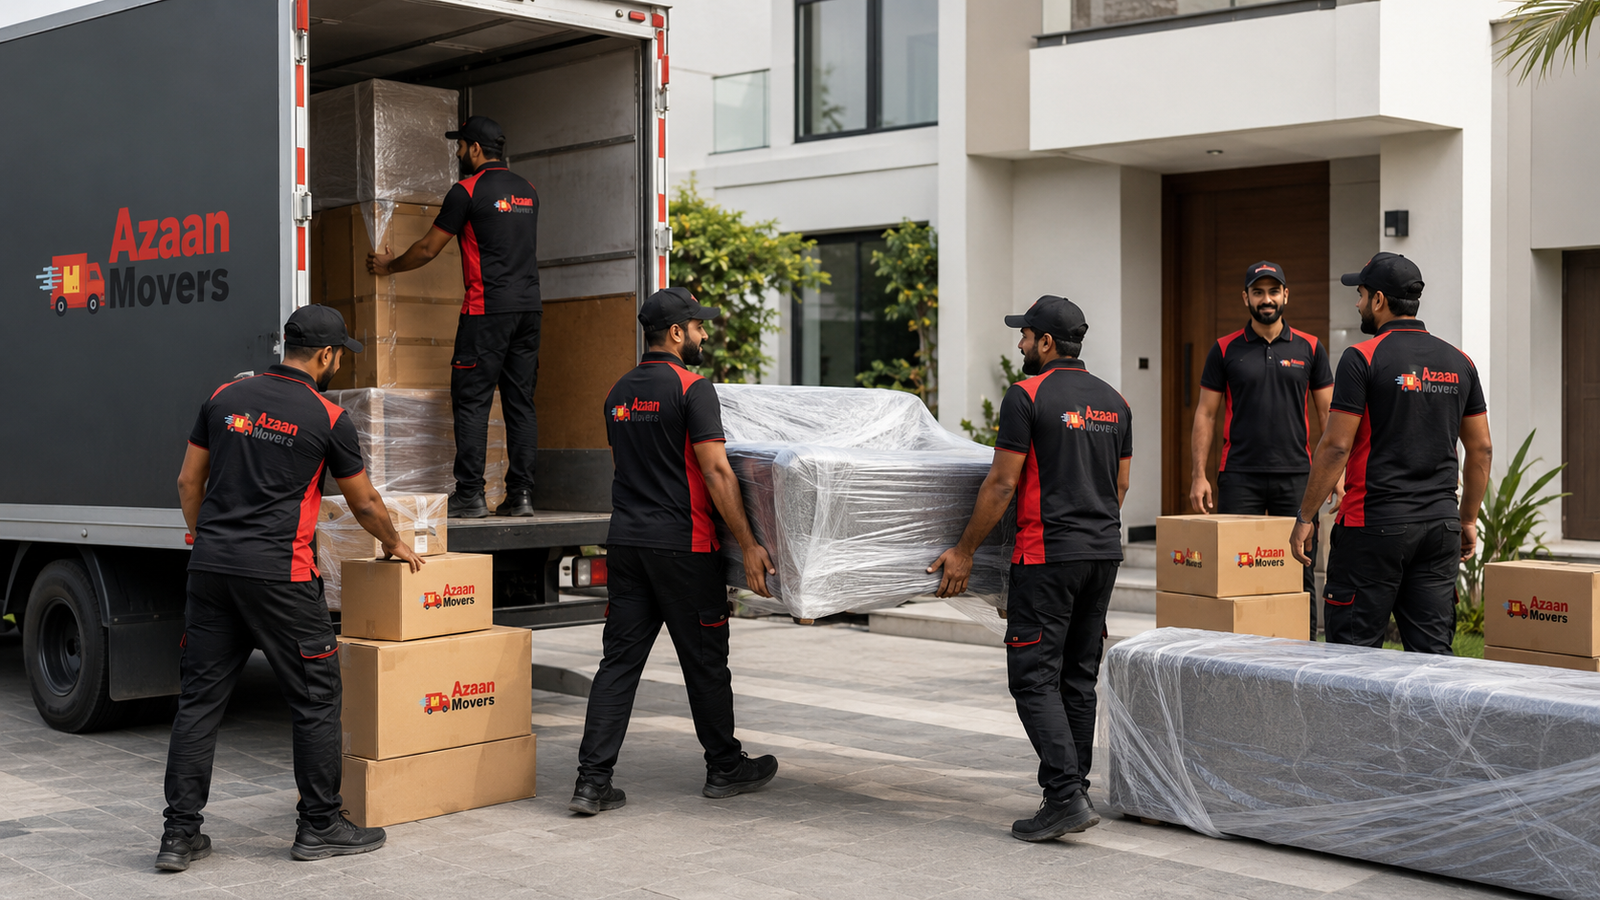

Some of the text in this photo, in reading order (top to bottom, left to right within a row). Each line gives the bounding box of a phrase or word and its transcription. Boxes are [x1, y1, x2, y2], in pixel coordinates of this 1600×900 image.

[108, 206, 230, 264] Azaan
[109, 266, 230, 309] Movers
[1422, 366, 1460, 384] Azaan
[1422, 381, 1459, 395] Movers
[631, 396, 660, 412] Azaan
[1085, 404, 1119, 424] Azaan
[254, 411, 299, 437] Azaan
[1085, 420, 1119, 435] Movers
[251, 426, 294, 447] Movers
[1255, 546, 1285, 558] Azaan
[1254, 558, 1285, 568] Movers
[443, 583, 475, 597] Azaan
[443, 596, 475, 608] Movers
[1530, 595, 1569, 613] Azaan
[1529, 609, 1568, 624] Movers
[451, 680, 495, 698] Azaan
[451, 696, 495, 711] Movers
